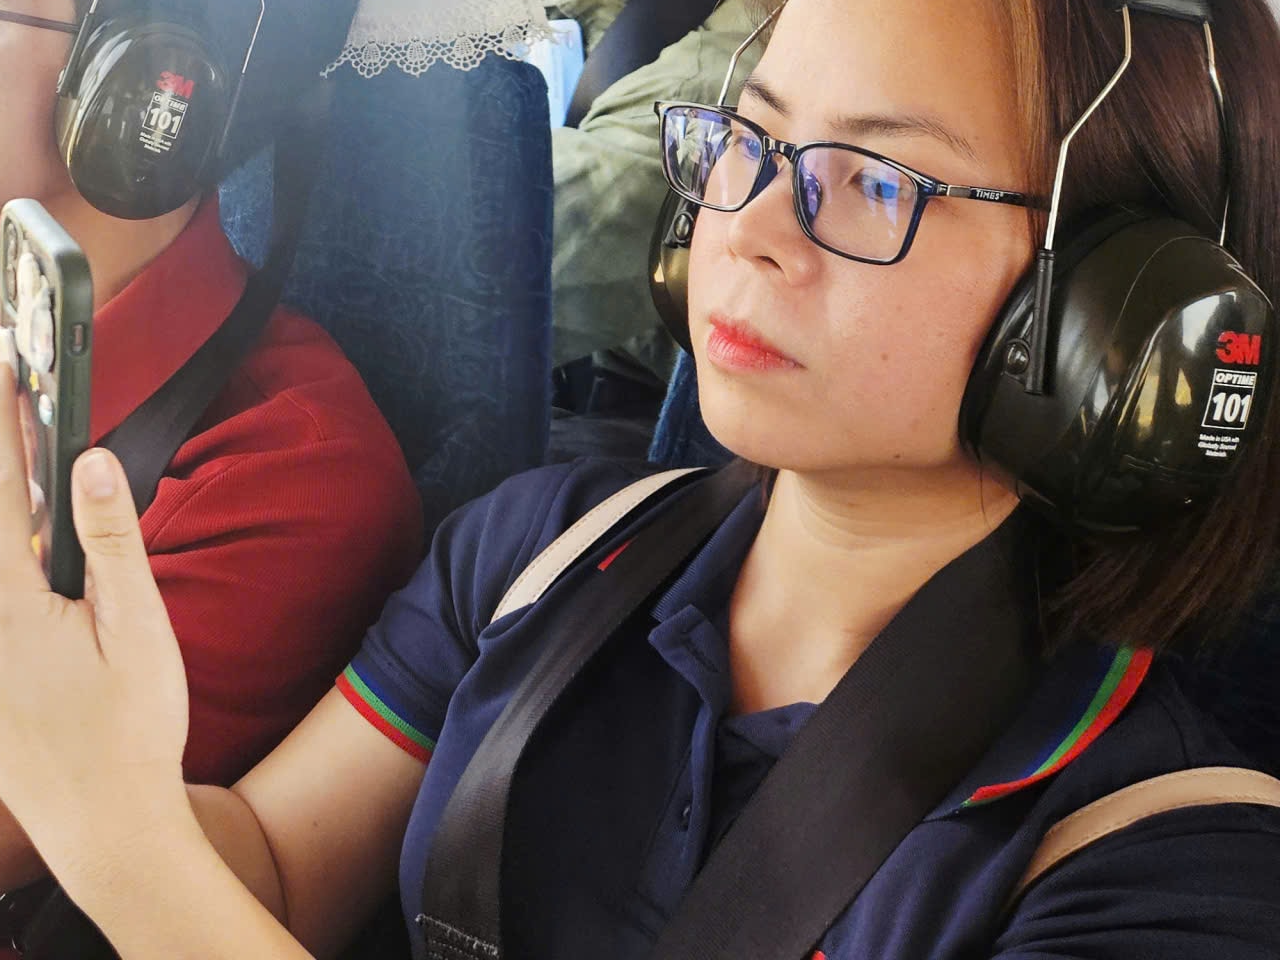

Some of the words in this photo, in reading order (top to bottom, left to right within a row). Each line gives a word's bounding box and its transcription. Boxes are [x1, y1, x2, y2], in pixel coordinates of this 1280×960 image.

[156, 71, 195, 99] 3M
[150, 107, 181, 134] 101
[1215, 330, 1262, 365] 3M
[1215, 373, 1256, 386] OPTIME
[1212, 392, 1252, 423] 101
